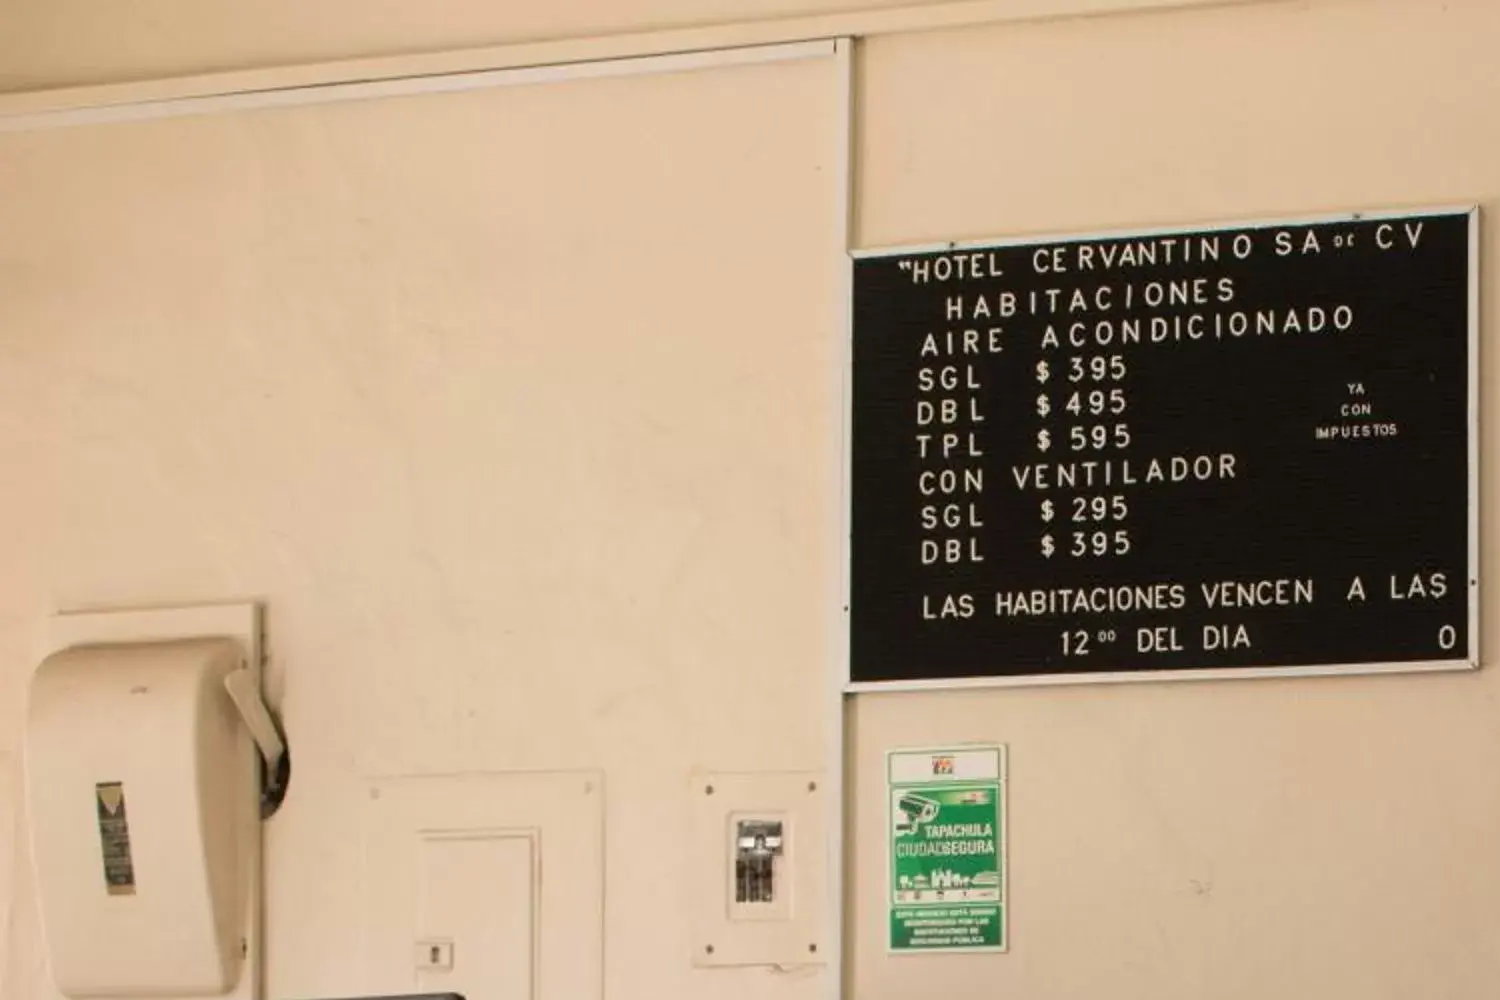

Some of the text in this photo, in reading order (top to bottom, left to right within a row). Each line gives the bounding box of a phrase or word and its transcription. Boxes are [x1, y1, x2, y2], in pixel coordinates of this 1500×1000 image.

[1032, 234, 1253, 274] CERVANTINO
[1275, 229, 1321, 256] SA
[1375, 222, 1423, 250] CV
[945, 278, 1235, 320] HABITACIONES
[920, 306, 1353, 357] AIRE ACONDICIONADO
[918, 356, 1125, 392] SGL $ 395
[1347, 383, 1365, 395] YA
[917, 388, 1126, 426] DBL $ 495
[1340, 403, 1371, 417] CON
[915, 423, 1131, 459] TPL $ 595
[1315, 423, 1397, 439] IMPUESTOS
[919, 453, 1236, 496] CON VENTILADOR
[921, 495, 1128, 530] SGL $ 295
[921, 530, 1130, 565] DBL $ 395
[923, 572, 1447, 620] LAS HABITACIONES VENCEN A LAS
[1061, 629, 1089, 656] 12
[1137, 626, 1184, 653] DEL
[1203, 624, 1251, 651] DIA
[925, 823, 993, 838] TAPACHULA
